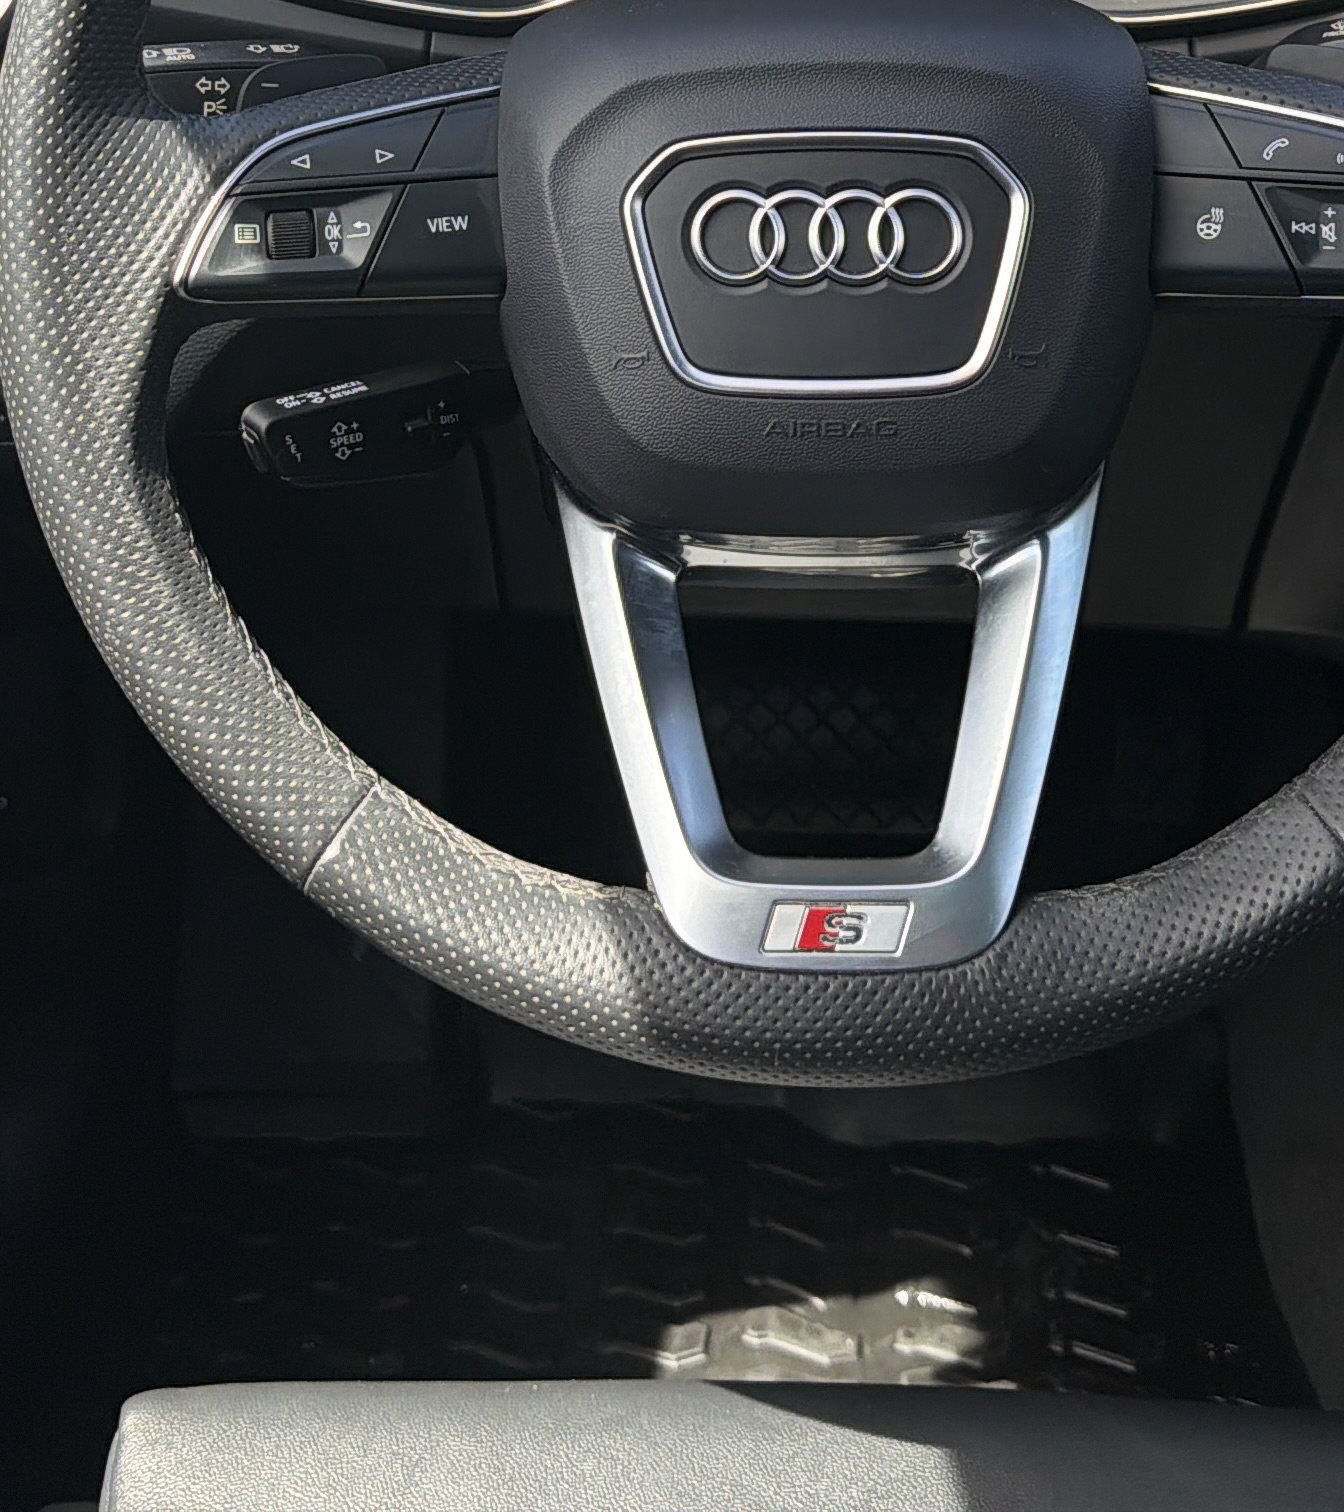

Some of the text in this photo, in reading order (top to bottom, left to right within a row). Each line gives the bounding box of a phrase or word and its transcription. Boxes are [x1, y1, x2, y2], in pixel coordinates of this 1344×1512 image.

[166, 54, 196, 62] AUTO
[324, 224, 342, 239] OK
[426, 215, 470, 233] VIEW
[323, 380, 364, 394] CANCEL
[329, 385, 370, 400] RESUME
[439, 413, 460, 425] DIST
[763, 418, 901, 439] AIRBAG
[329, 432, 364, 448] SPEED
[284, 434, 303, 463] SET
[820, 911, 868, 946] S
